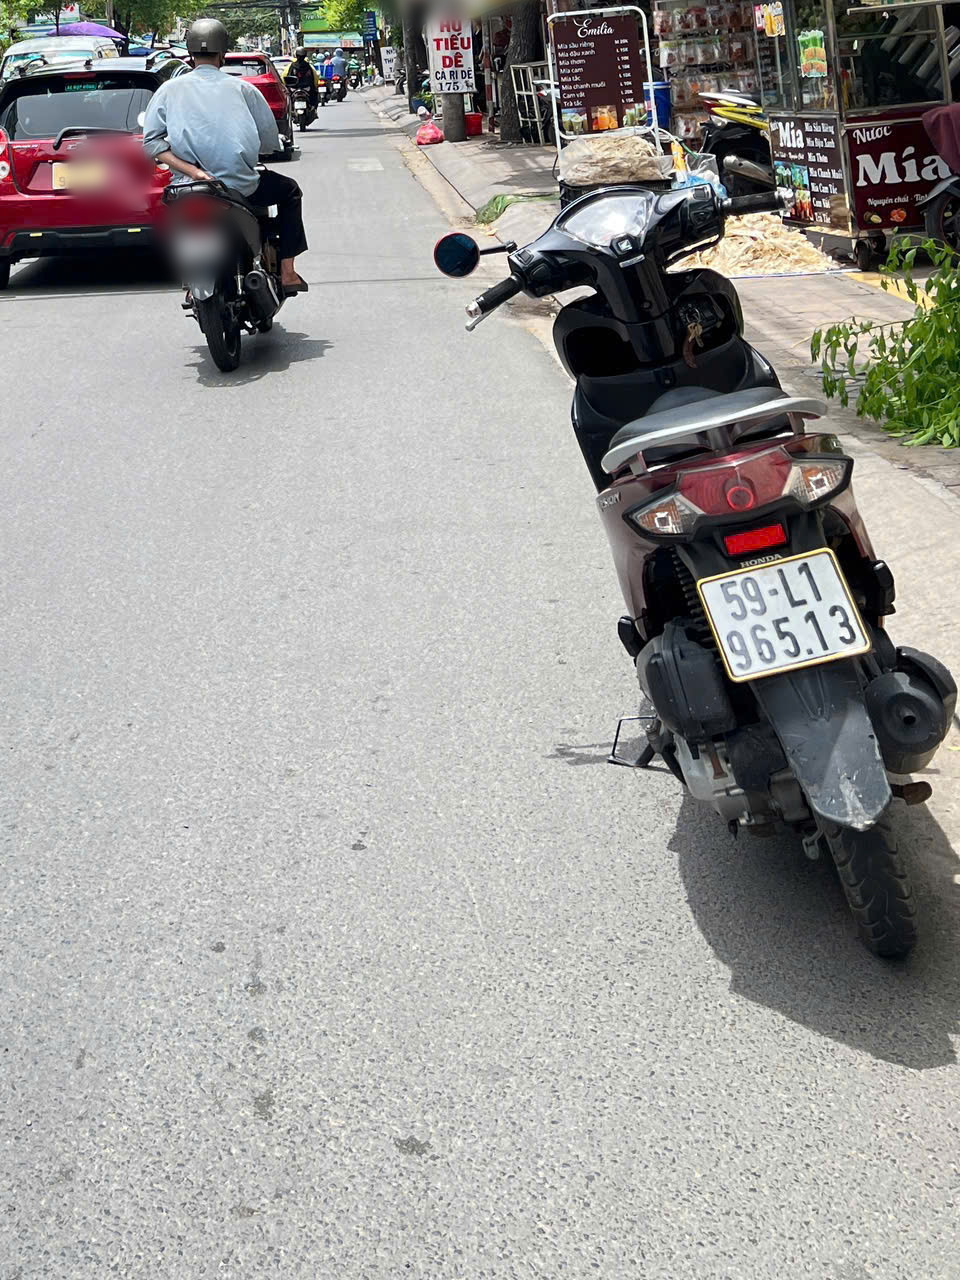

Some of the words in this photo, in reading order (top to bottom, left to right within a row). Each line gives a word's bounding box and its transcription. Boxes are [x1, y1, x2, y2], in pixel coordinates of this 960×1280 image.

[574, 19, 615, 38] Emilia
[433, 33, 471, 51] TIẾU
[441, 52, 464, 68] DÊ
[449, 71, 458, 79] RI
[439, 82, 460, 91] 175
[856, 146, 952, 187] Mía
[740, 554, 784, 568] HONDA
[720, 562, 822, 620] 59-L1
[726, 605, 856, 670] 965.13
